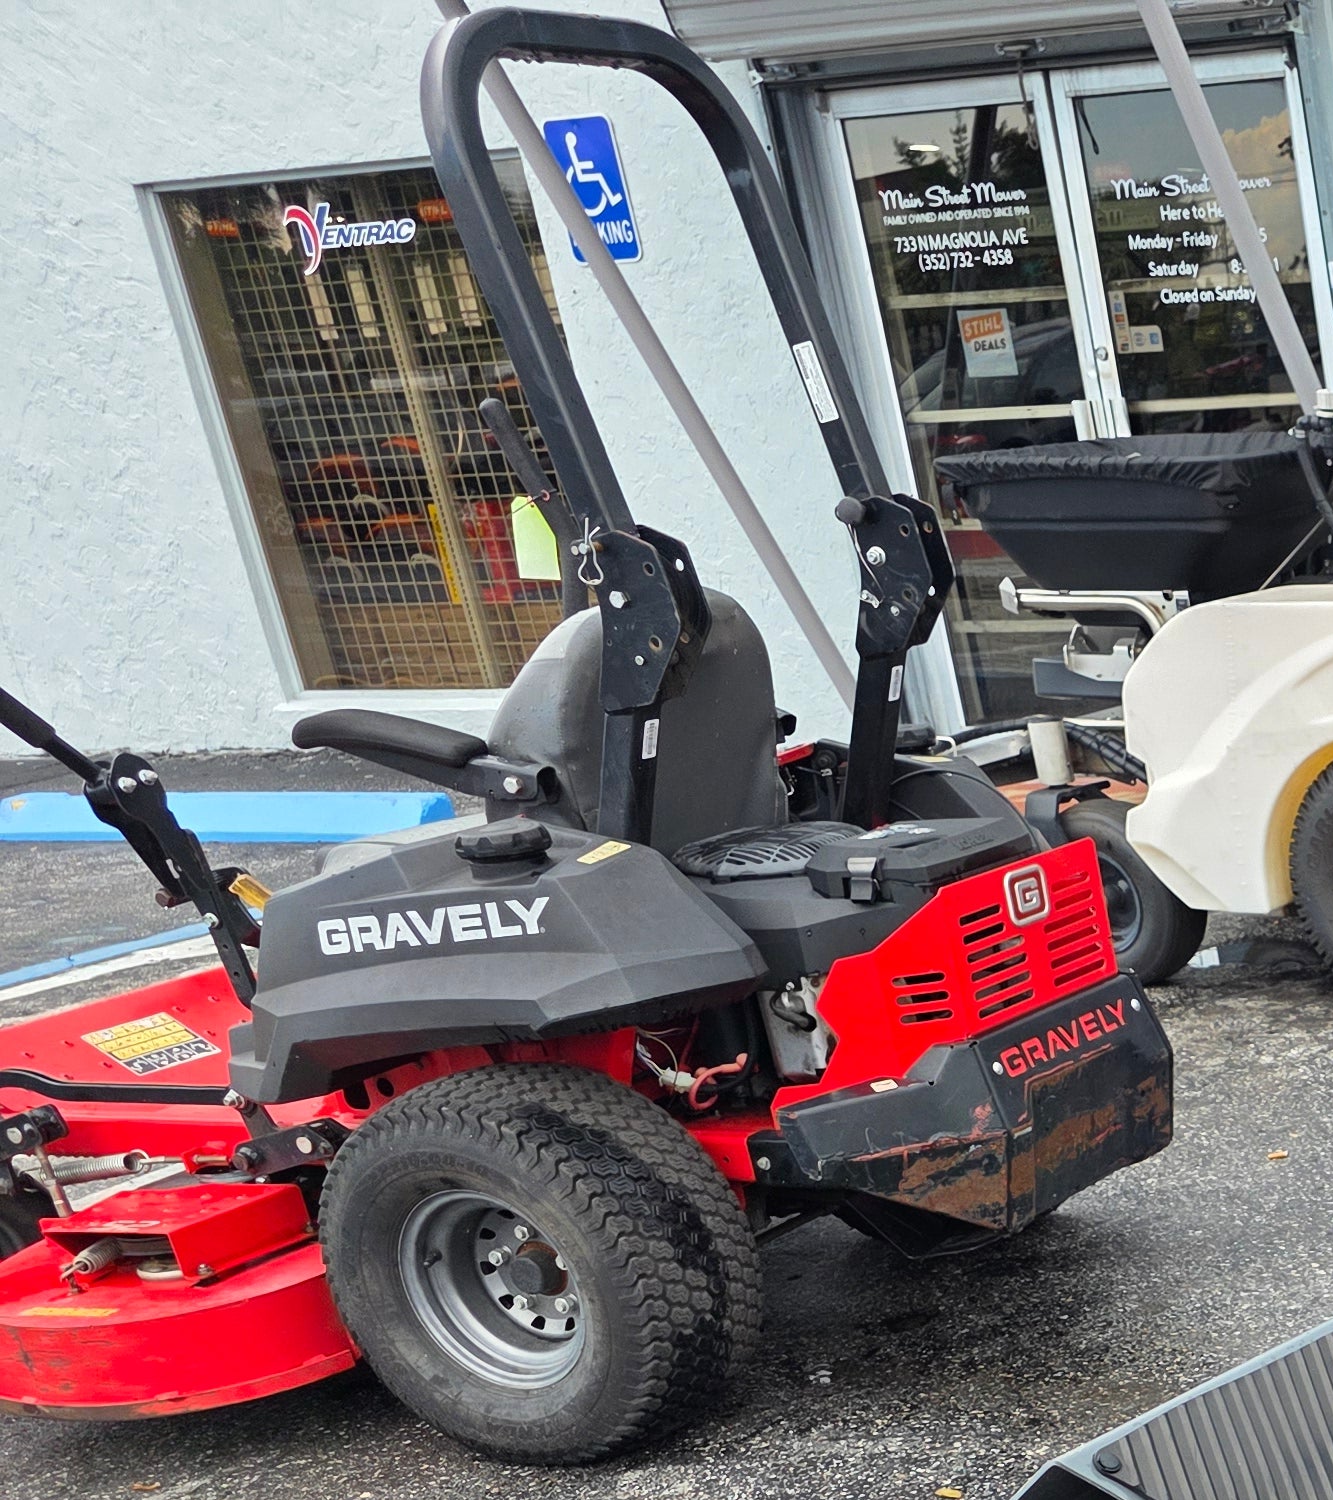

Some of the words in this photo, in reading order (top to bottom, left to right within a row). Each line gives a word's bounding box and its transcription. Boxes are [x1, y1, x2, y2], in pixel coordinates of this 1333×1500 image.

[879, 189, 924, 211] Main
[925, 183, 972, 207] Street
[971, 181, 1027, 204] Mower
[1111, 178, 1160, 200] Main
[1161, 173, 1211, 197] Street
[1238, 176, 1272, 191] ower
[883, 214, 908, 227] FAMILY
[908, 212, 937, 225] OWNED
[938, 210, 954, 222] AND
[955, 208, 992, 221] OPERATED
[993, 206, 1013, 217] SINCE
[1160, 204, 1190, 221] Here
[1192, 205, 1206, 219] to
[283, 202, 416, 275] VENTRAC
[894, 236, 917, 253] 733
[929, 230, 1000, 251] MAGNOLIA
[1002, 227, 1029, 245] AVE
[1128, 233, 1174, 251] Monday
[1182, 231, 1218, 249] Friday
[1148, 260, 1199, 278] Saturday
[1160, 287, 1199, 304] Closed
[1199, 290, 1215, 302] on
[1215, 285, 1257, 303] Sunday
[964, 316, 1001, 338] STIHL
[974, 338, 1007, 352] DEALS
[317, 896, 549, 956] GRAVELY
[1000, 999, 1128, 1079] GRAVELY
